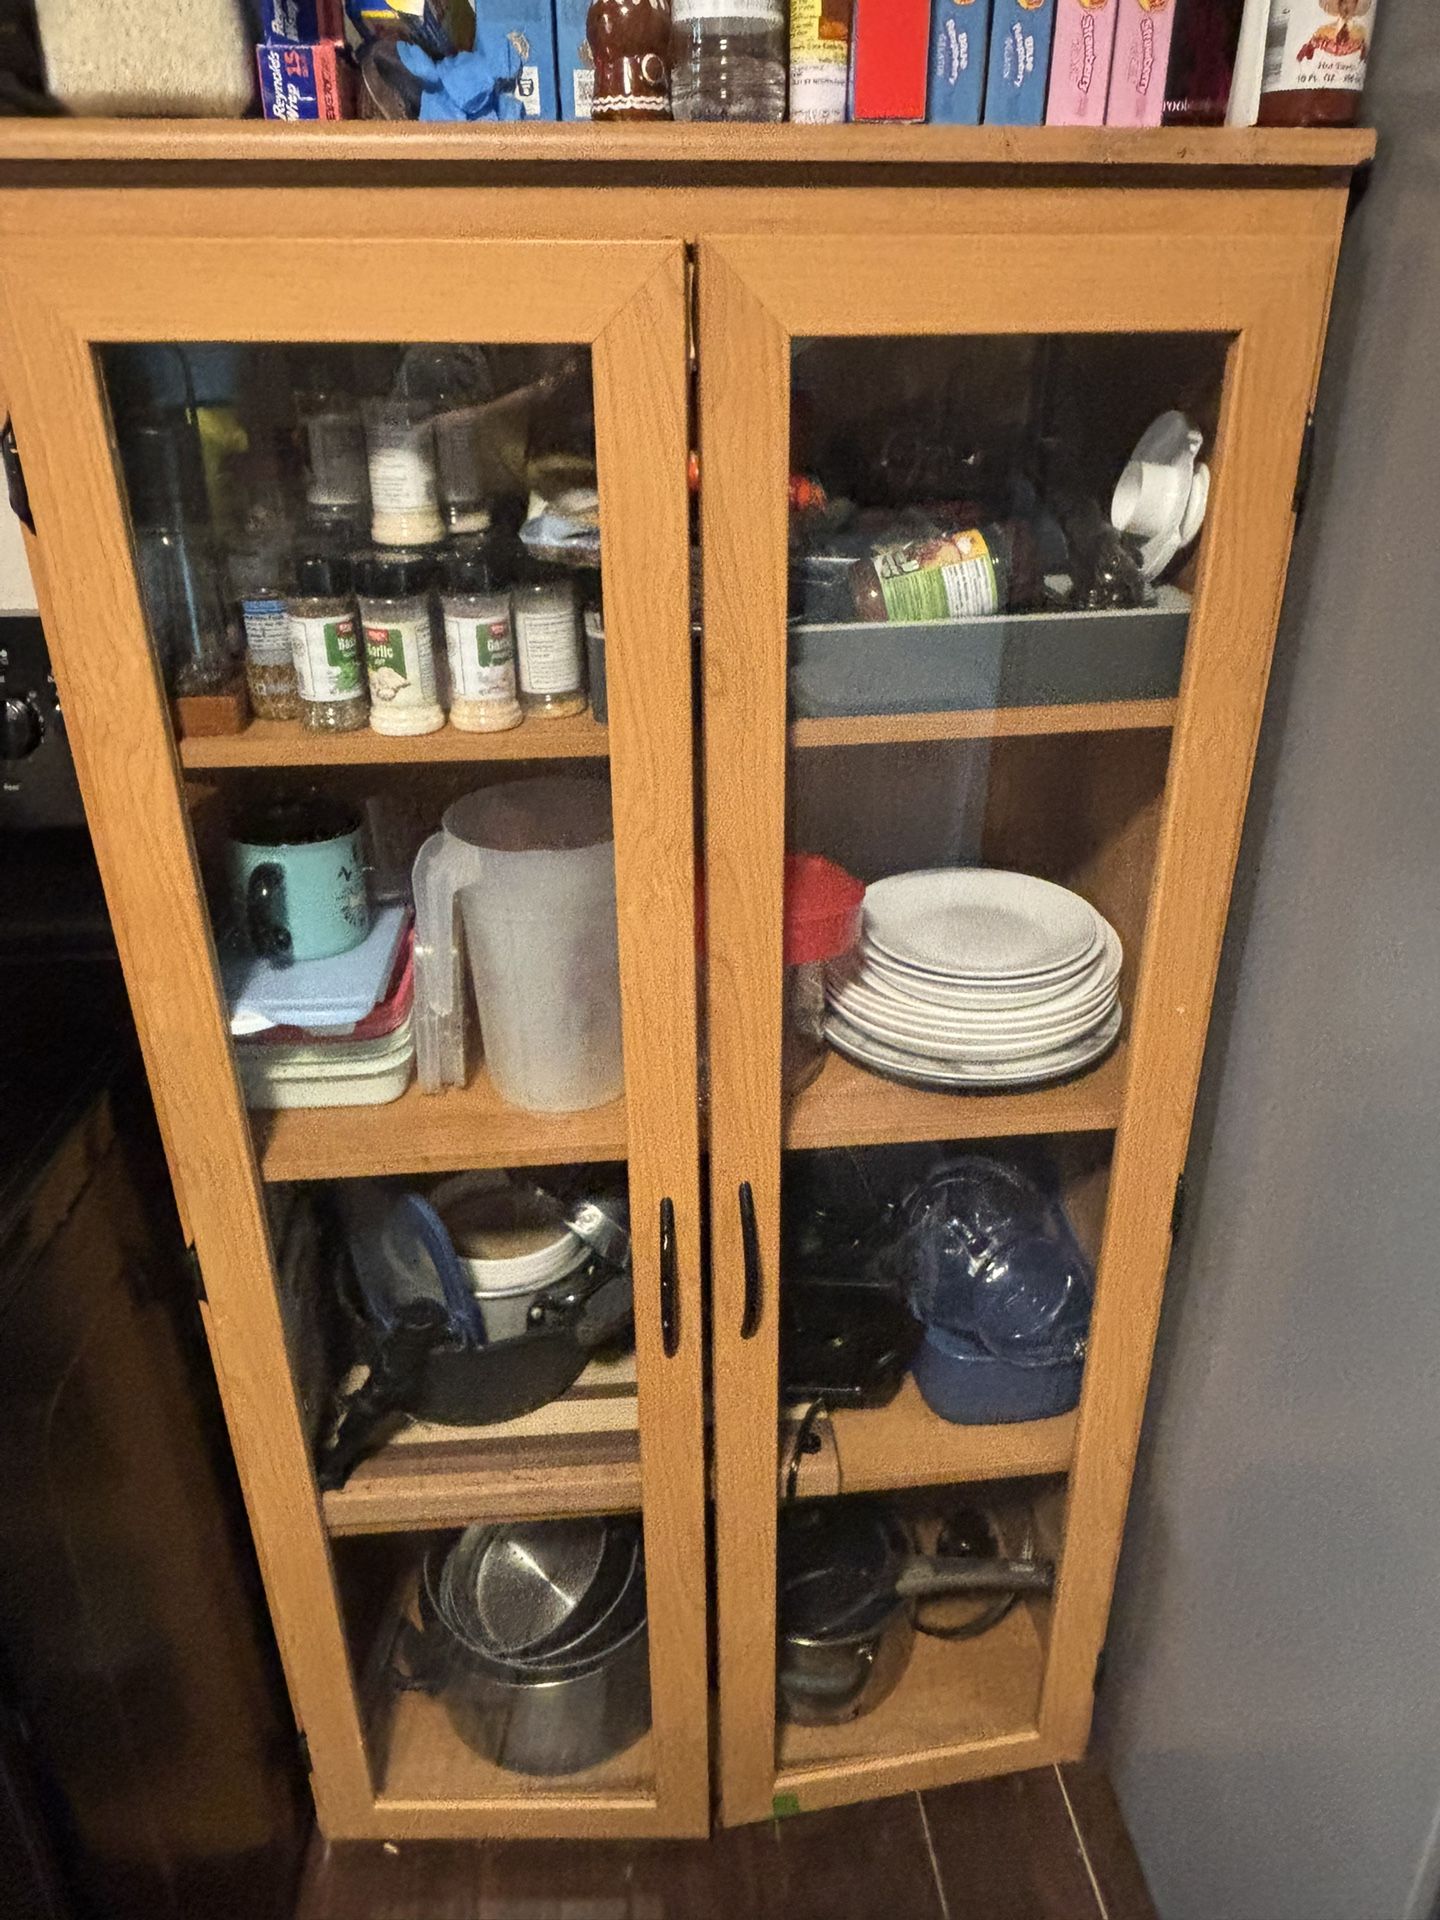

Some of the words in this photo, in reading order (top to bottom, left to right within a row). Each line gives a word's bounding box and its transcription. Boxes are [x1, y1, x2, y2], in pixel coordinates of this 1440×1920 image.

[267, 50, 287, 121] Reynolds
[1078, 13, 1096, 94] Strawberry
[1136, 16, 1154, 96] Strawberry
[284, 83, 301, 121] Wrap
